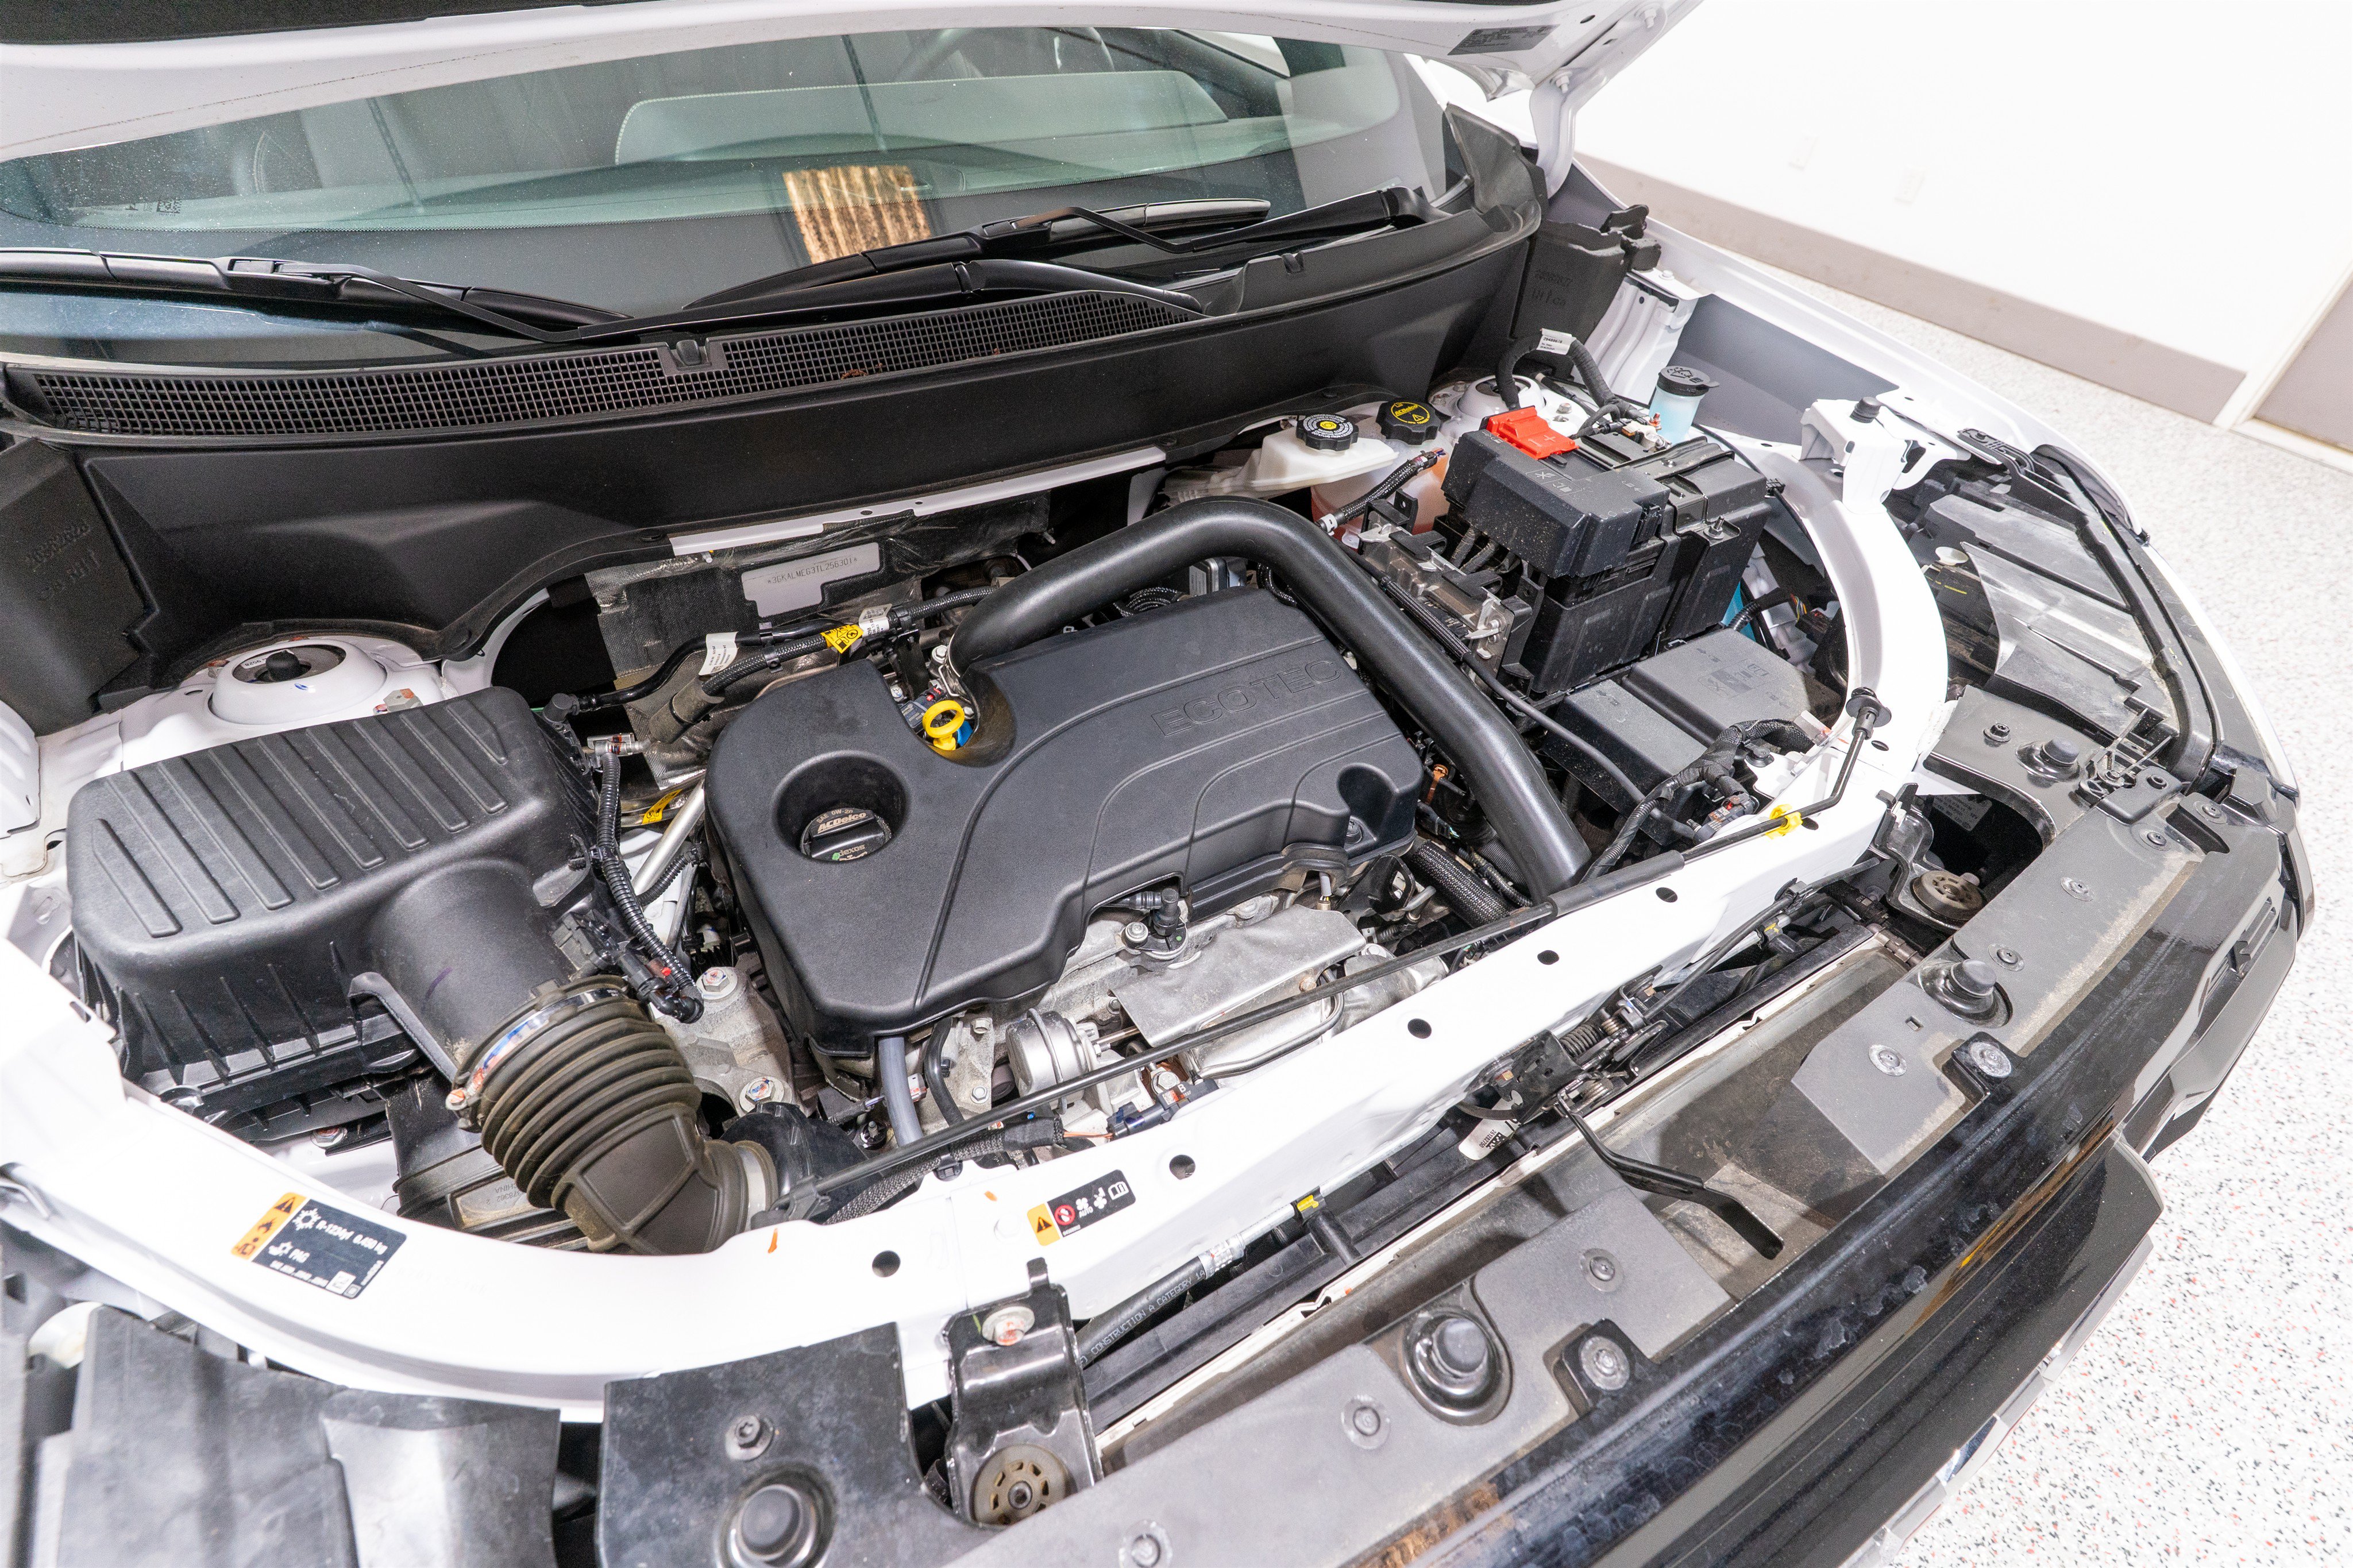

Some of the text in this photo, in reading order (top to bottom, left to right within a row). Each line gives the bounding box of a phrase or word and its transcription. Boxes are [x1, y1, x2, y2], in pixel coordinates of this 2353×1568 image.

[1395, 404, 1418, 416] ACDelco
[1151, 661, 1341, 737] ECOTEC
[816, 813, 830, 823] SAE
[817, 812, 867, 833] ACDelco
[1178, 1083, 1186, 1093] B
[1078, 1206, 1094, 1218] AUTO
[288, 1248, 311, 1264] PAG
[1091, 1309, 1147, 1355] CONSTRUCTION
[1148, 1304, 1155, 1312] A
[1156, 1278, 1193, 1307] CATEGORY
[1195, 1269, 1205, 1280] 1A
